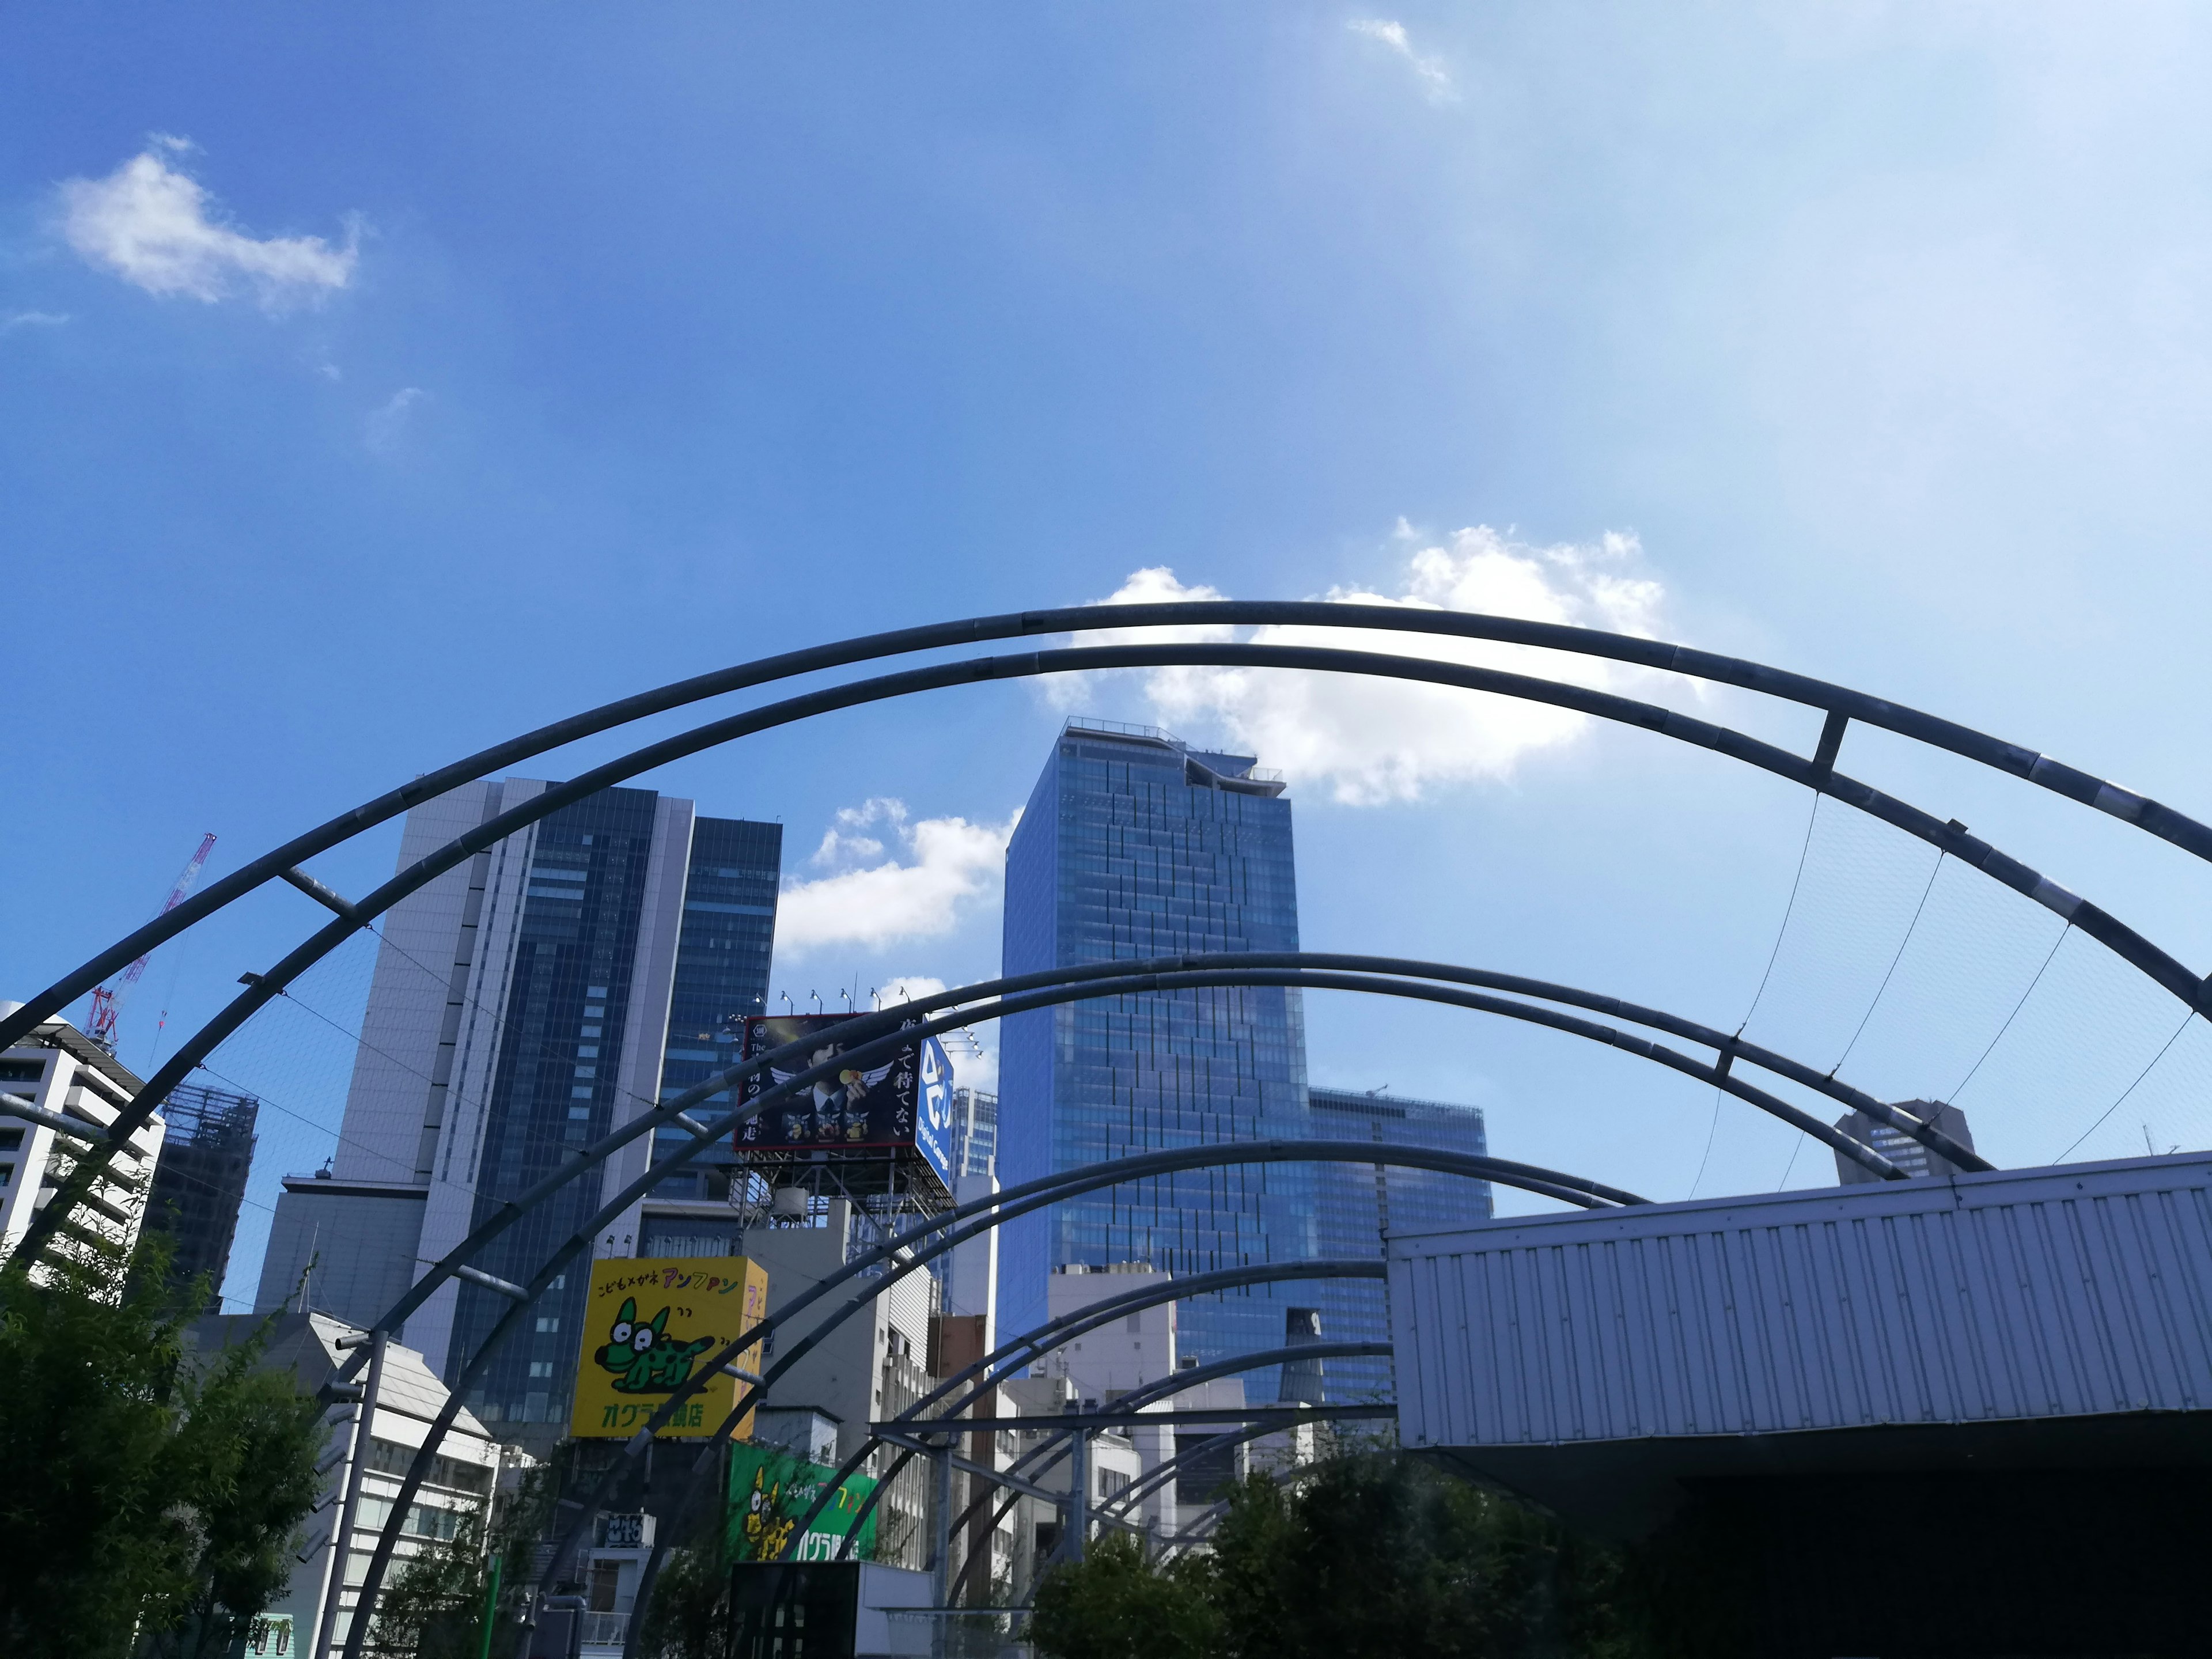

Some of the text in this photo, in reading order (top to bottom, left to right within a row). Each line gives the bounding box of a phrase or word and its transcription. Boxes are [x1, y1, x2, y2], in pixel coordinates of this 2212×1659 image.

[751, 1043, 766, 1052] The
[742, 1052, 760, 1141] 物の馳走
[918, 1116, 934, 1148] Digital
[599, 1270, 659, 1297] こどもメガネ
[602, 1403, 704, 1427] オグラ鏡店
